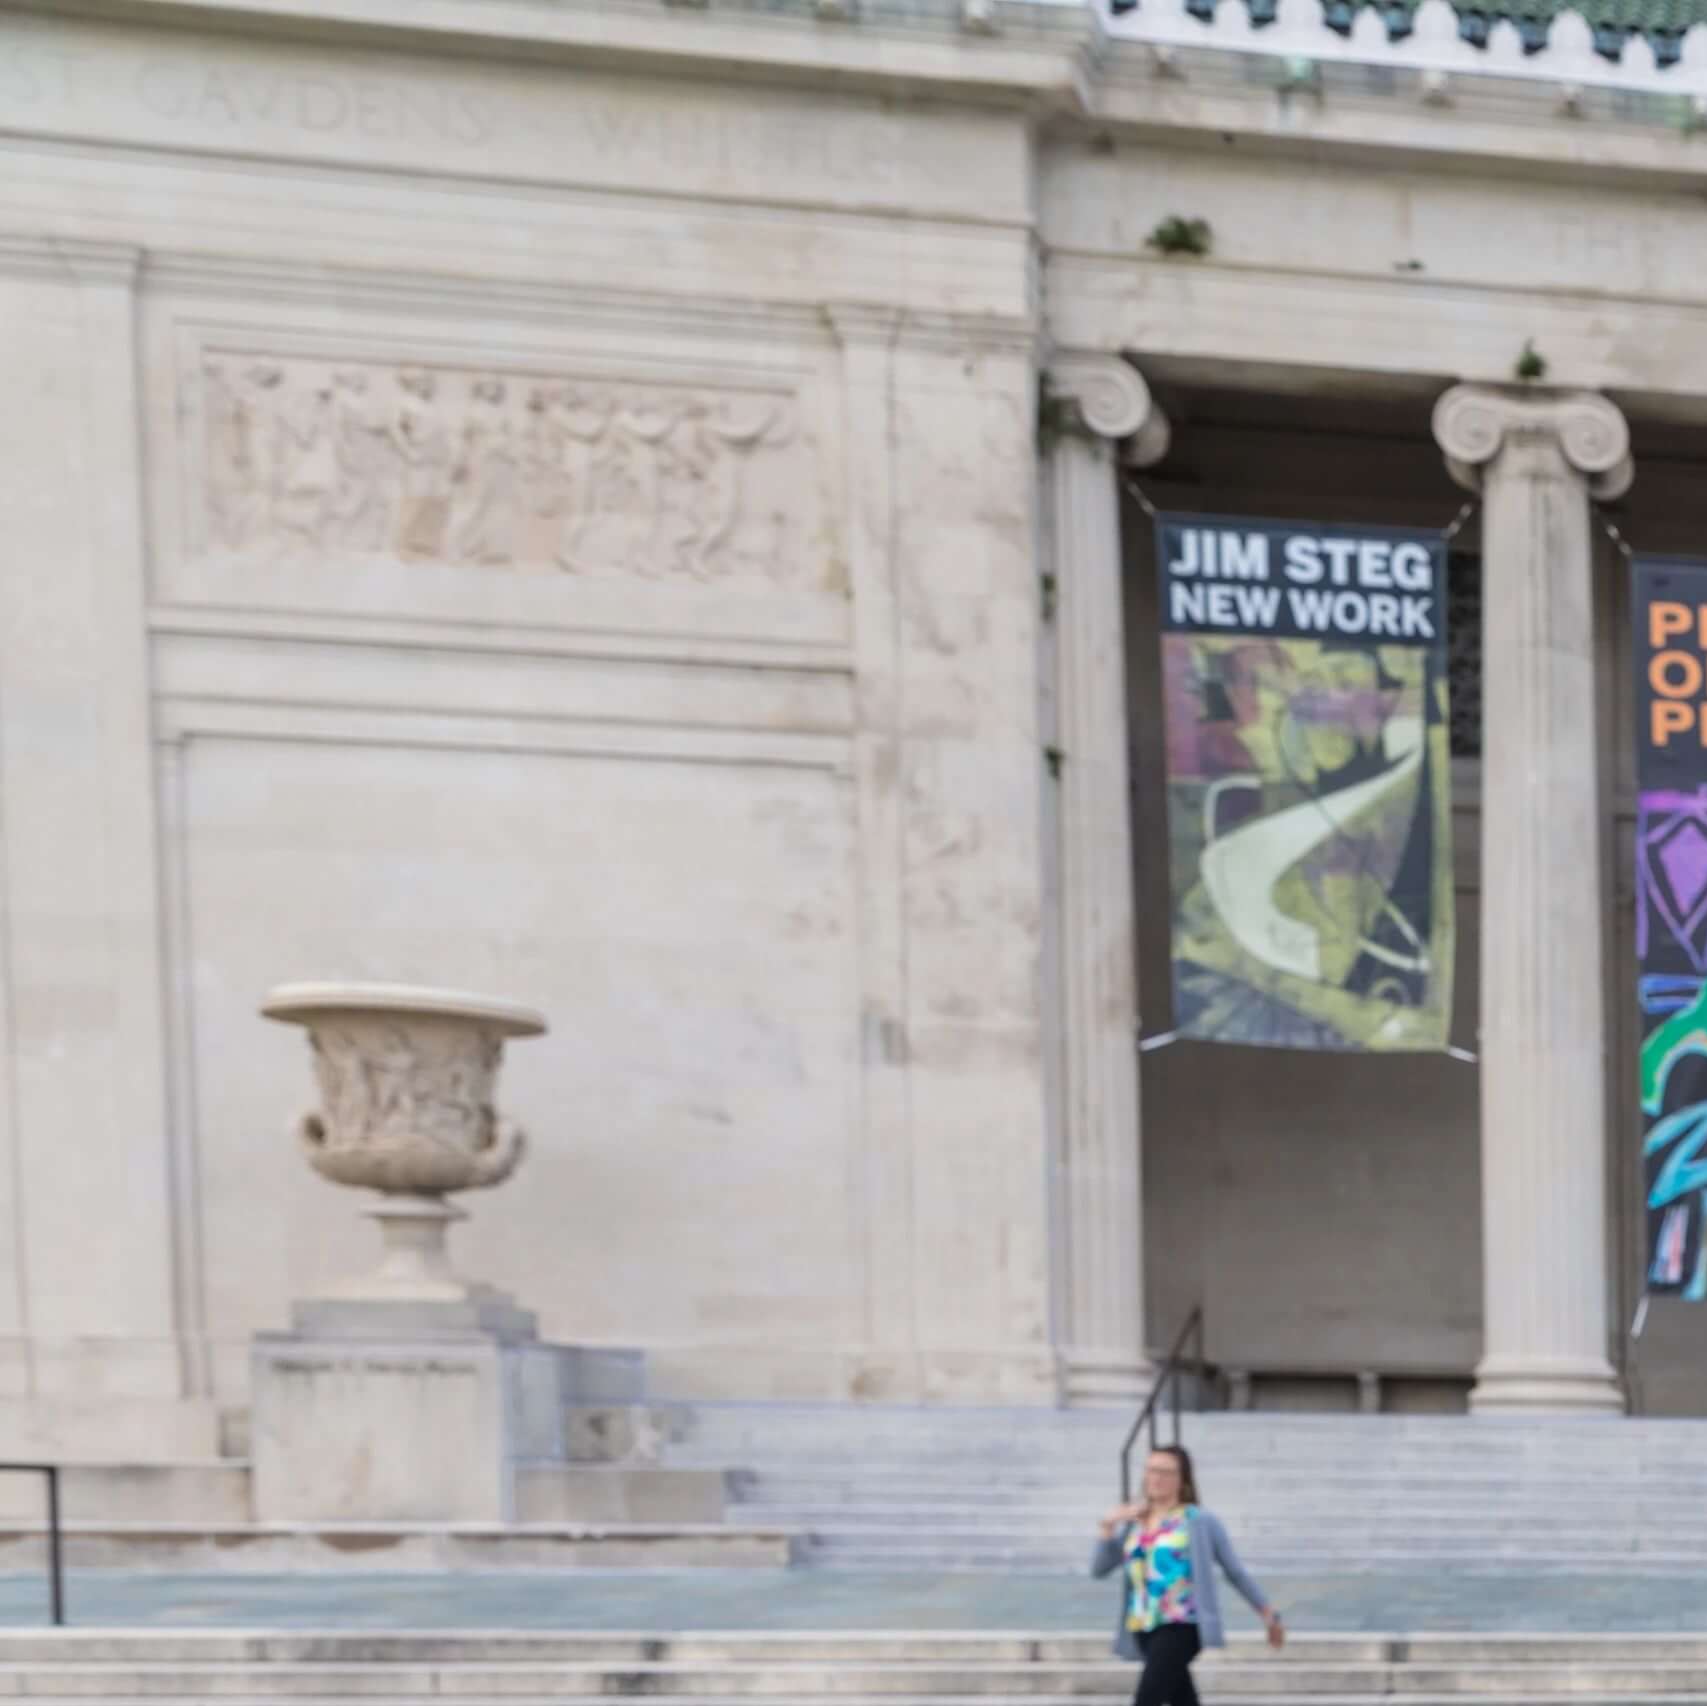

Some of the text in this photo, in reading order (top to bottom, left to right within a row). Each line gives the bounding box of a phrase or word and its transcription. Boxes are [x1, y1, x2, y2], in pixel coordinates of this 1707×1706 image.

[133, 60, 495, 148] GAVDENS
[1169, 529, 1433, 591] JIM STEG
[1169, 581, 1436, 639] NEW WORK
